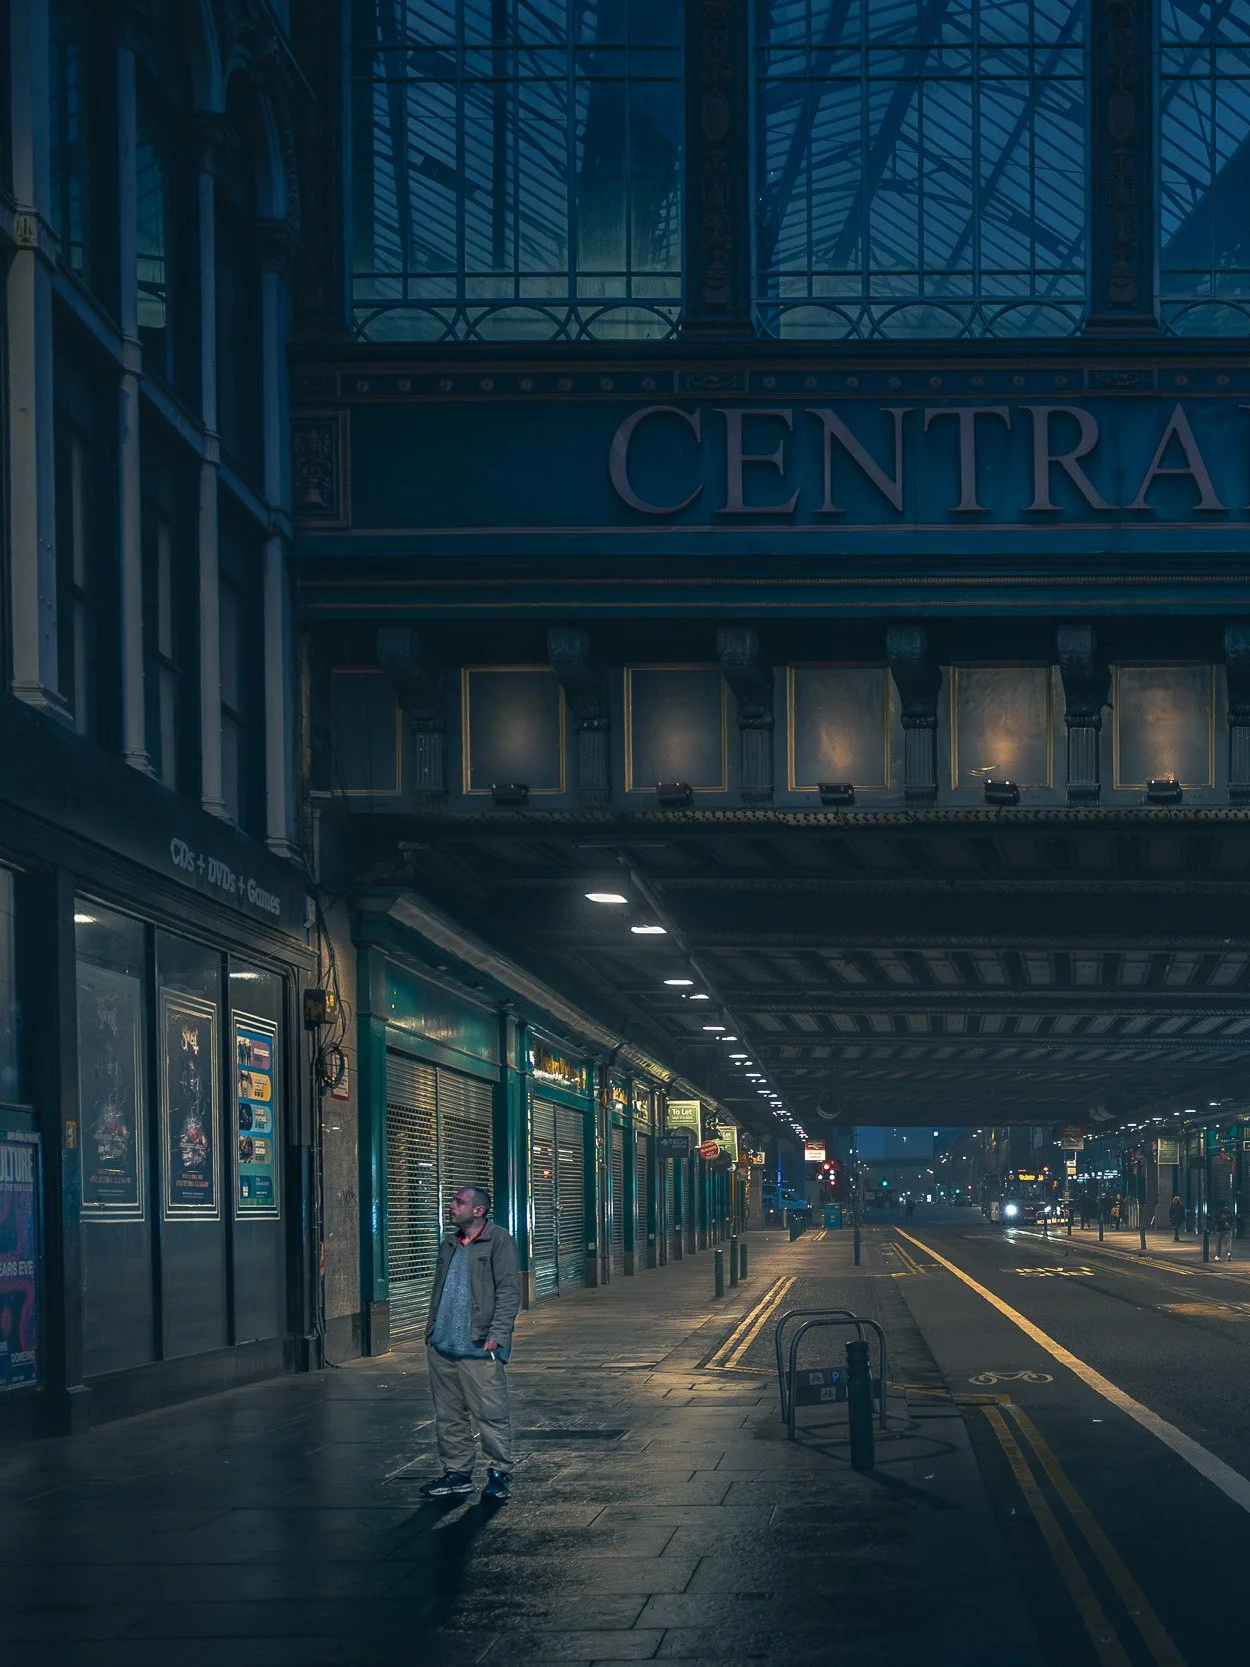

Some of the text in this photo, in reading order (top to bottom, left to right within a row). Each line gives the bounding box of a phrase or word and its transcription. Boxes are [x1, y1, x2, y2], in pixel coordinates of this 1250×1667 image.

[170, 837, 195, 872] CDs
[208, 856, 236, 894] DVDs
[247, 878, 281, 916] Games
[19, 1260, 33, 1275] EVE
[832, 1371, 840, 1383] P
